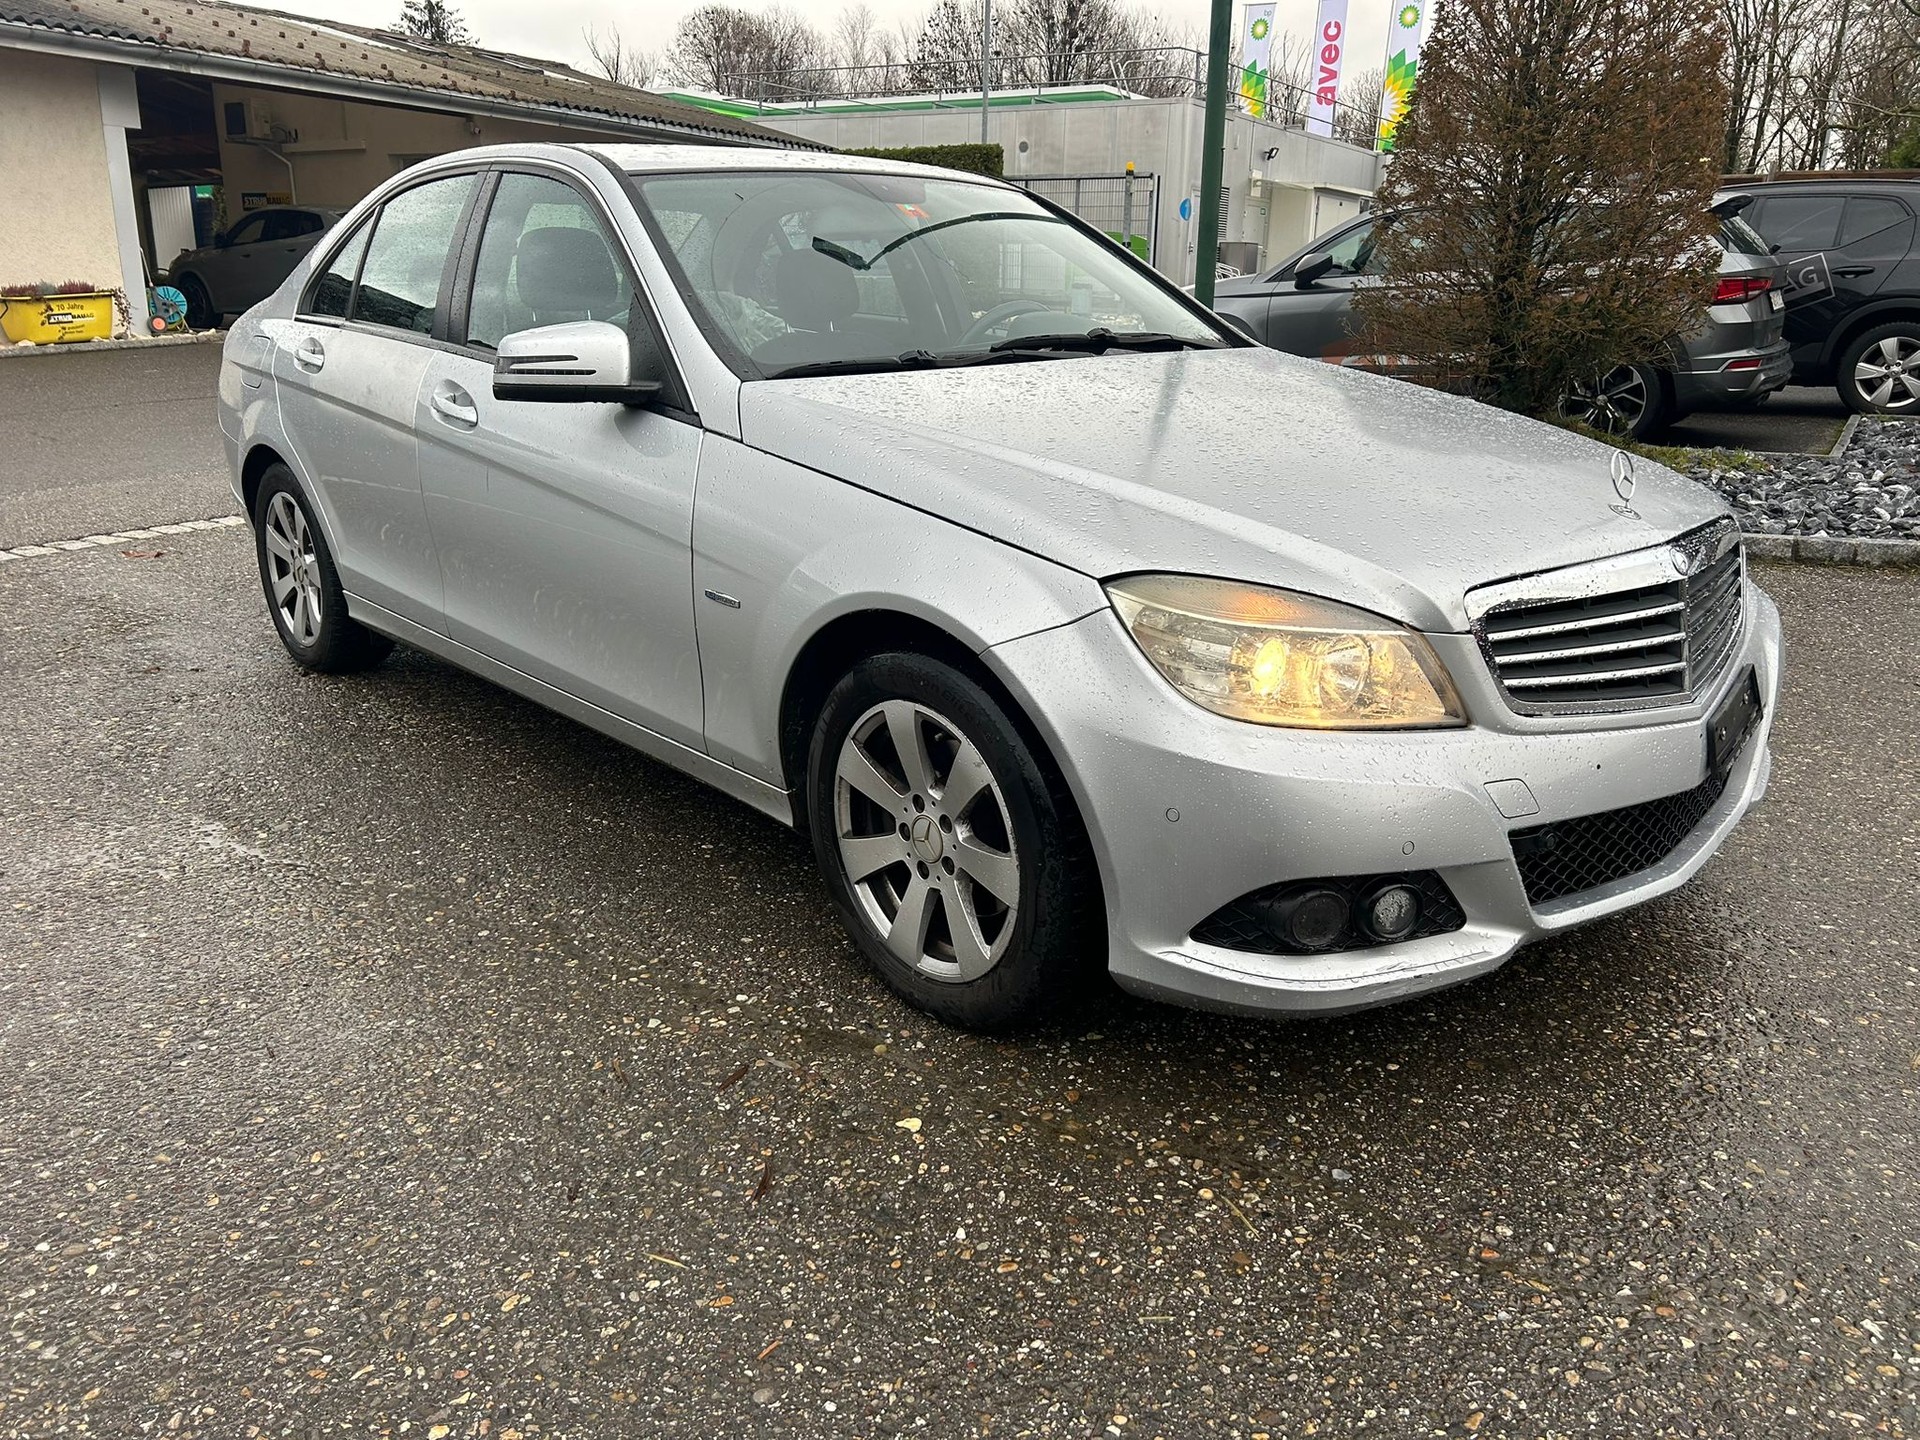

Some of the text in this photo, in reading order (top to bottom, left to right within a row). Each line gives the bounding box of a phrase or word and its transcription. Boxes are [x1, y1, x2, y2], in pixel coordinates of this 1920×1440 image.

[1263, 9, 1272, 17] bp
[1316, 20, 1341, 106] avec
[66, 302, 84, 311] Jahre
